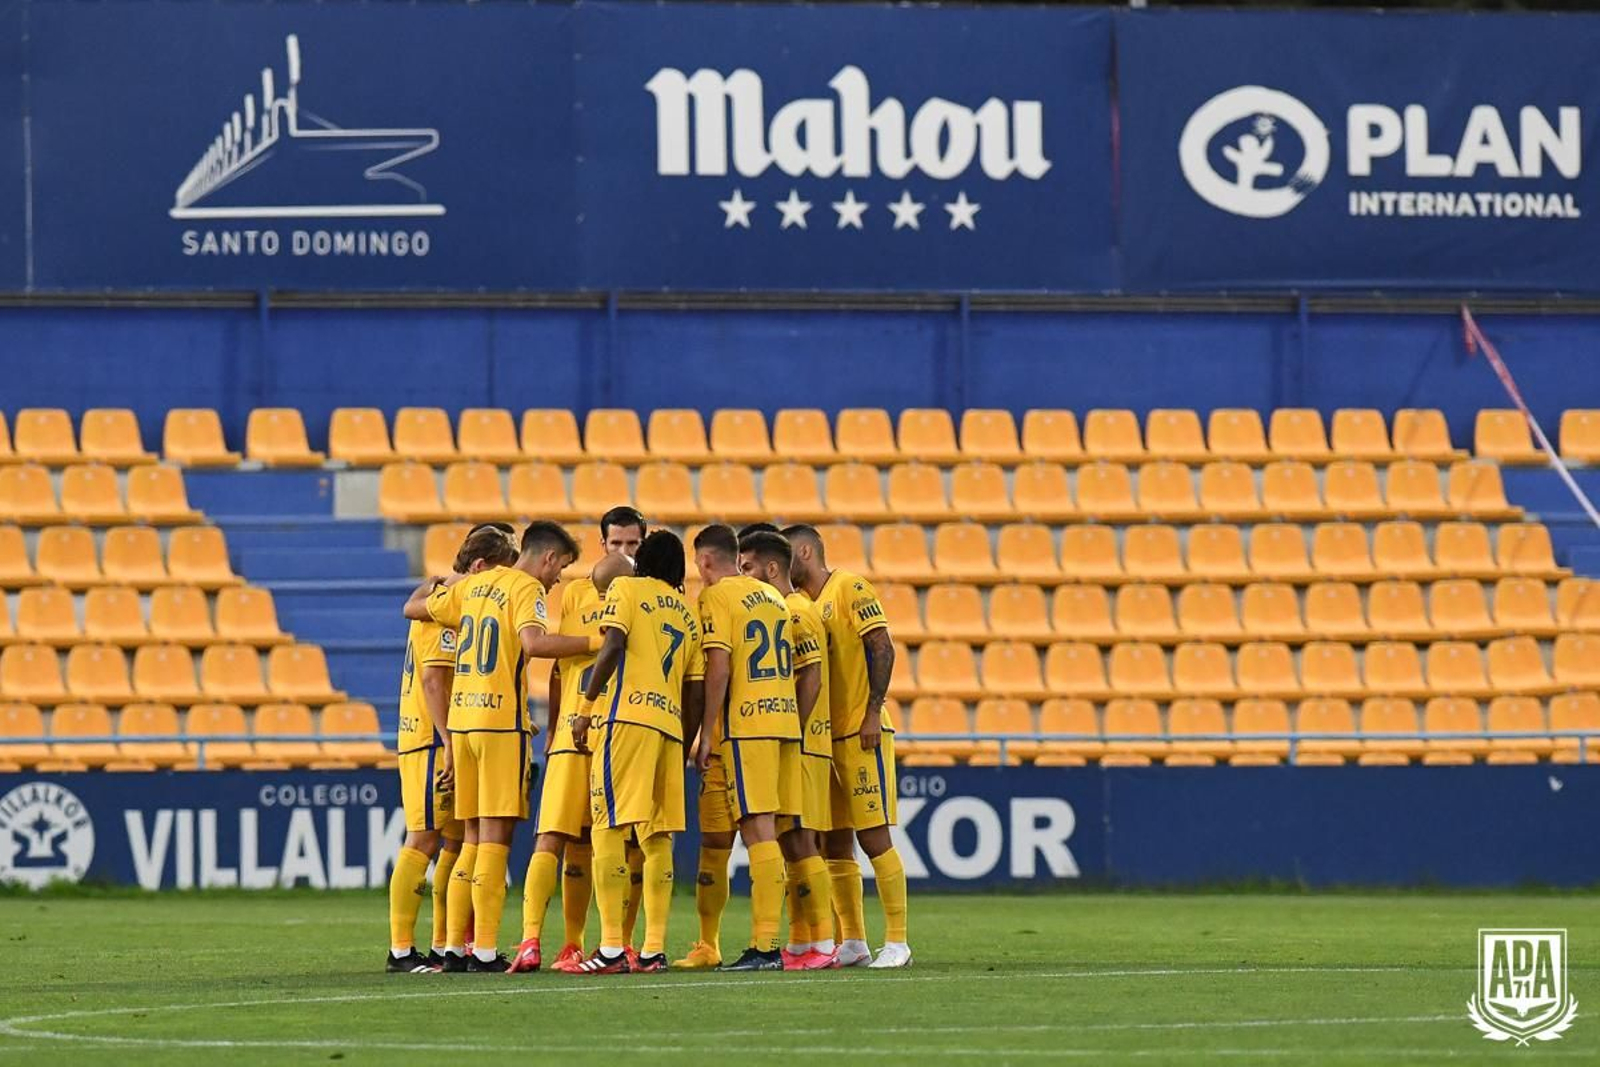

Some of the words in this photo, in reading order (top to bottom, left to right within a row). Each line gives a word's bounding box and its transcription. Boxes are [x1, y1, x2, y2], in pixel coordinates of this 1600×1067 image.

[644, 65, 1052, 180] Mahou
[1346, 104, 1582, 179] PLAN
[1348, 191, 1581, 218] INTERNATIONAL
[181, 230, 280, 256] SANTO
[291, 230, 430, 256] DOMINGO
[454, 613, 500, 676] 20
[661, 622, 685, 684] 7
[743, 618, 792, 684] 26
[259, 785, 378, 806] COLEGIO
[124, 807, 512, 889] VILLALK
